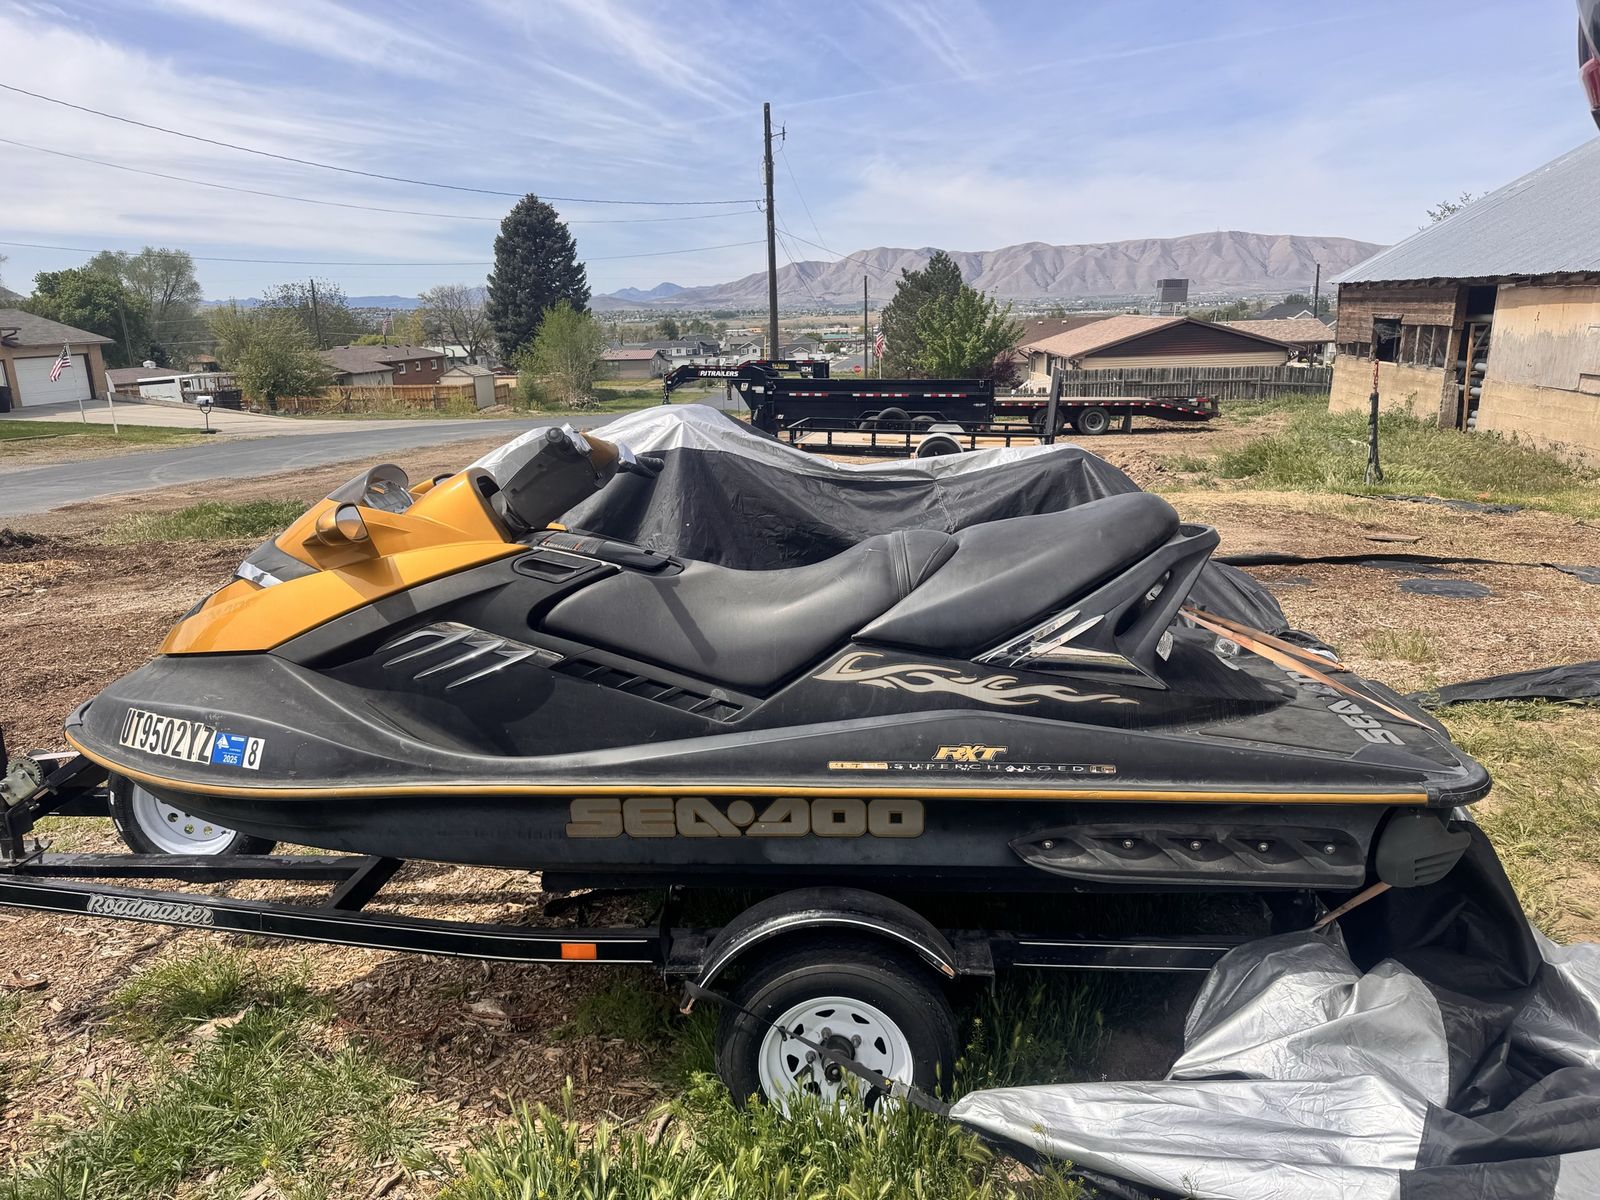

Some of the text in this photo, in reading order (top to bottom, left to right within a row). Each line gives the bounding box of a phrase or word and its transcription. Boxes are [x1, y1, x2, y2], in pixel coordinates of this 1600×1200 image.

[223, 754, 238, 764] 2025
[248, 739, 259, 767] 8
[932, 743, 1008, 762] RXT
[87, 893, 214, 926] Roadmaster
